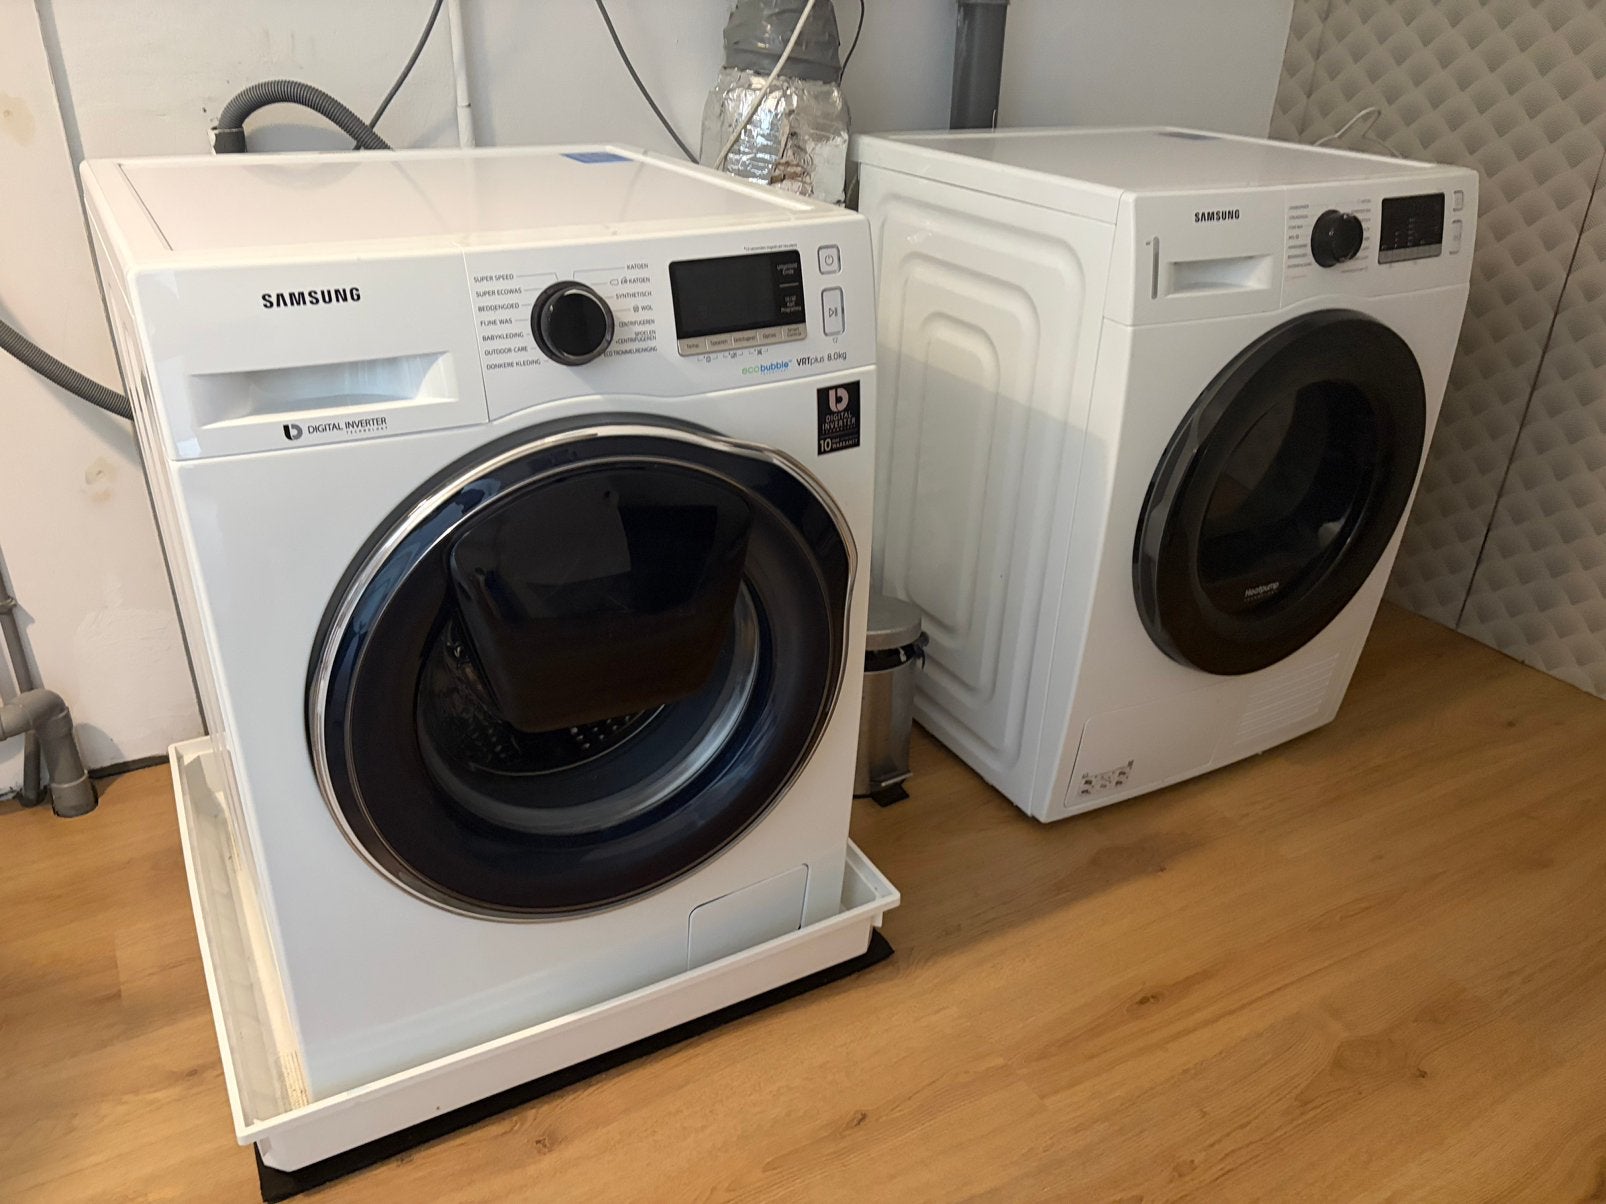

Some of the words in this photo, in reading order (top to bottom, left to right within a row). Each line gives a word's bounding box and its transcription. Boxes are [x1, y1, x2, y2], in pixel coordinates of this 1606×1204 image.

[1194, 209, 1240, 223] SAMSUNG
[494, 273, 514, 281] SPEED
[261, 287, 361, 309] SAMSUNG
[475, 290, 496, 298] SUPER
[496, 287, 522, 296] ECOWAS
[616, 290, 652, 300] SYNTHETISCH
[478, 303, 520, 313] BEDDENGOED
[482, 332, 524, 342] BABYKLEDING
[484, 347, 512, 356] OUTDOOR
[827, 351, 847, 362] 8.0kg
[486, 361, 514, 370] DONKERE
[515, 359, 541, 367] KLEDING
[826, 410, 852, 423] DIGITAL
[307, 422, 343, 434] DIGITAL
[344, 416, 387, 430] INVERTER
[822, 416, 856, 431] INVERTER
[820, 438, 832, 452] 10
